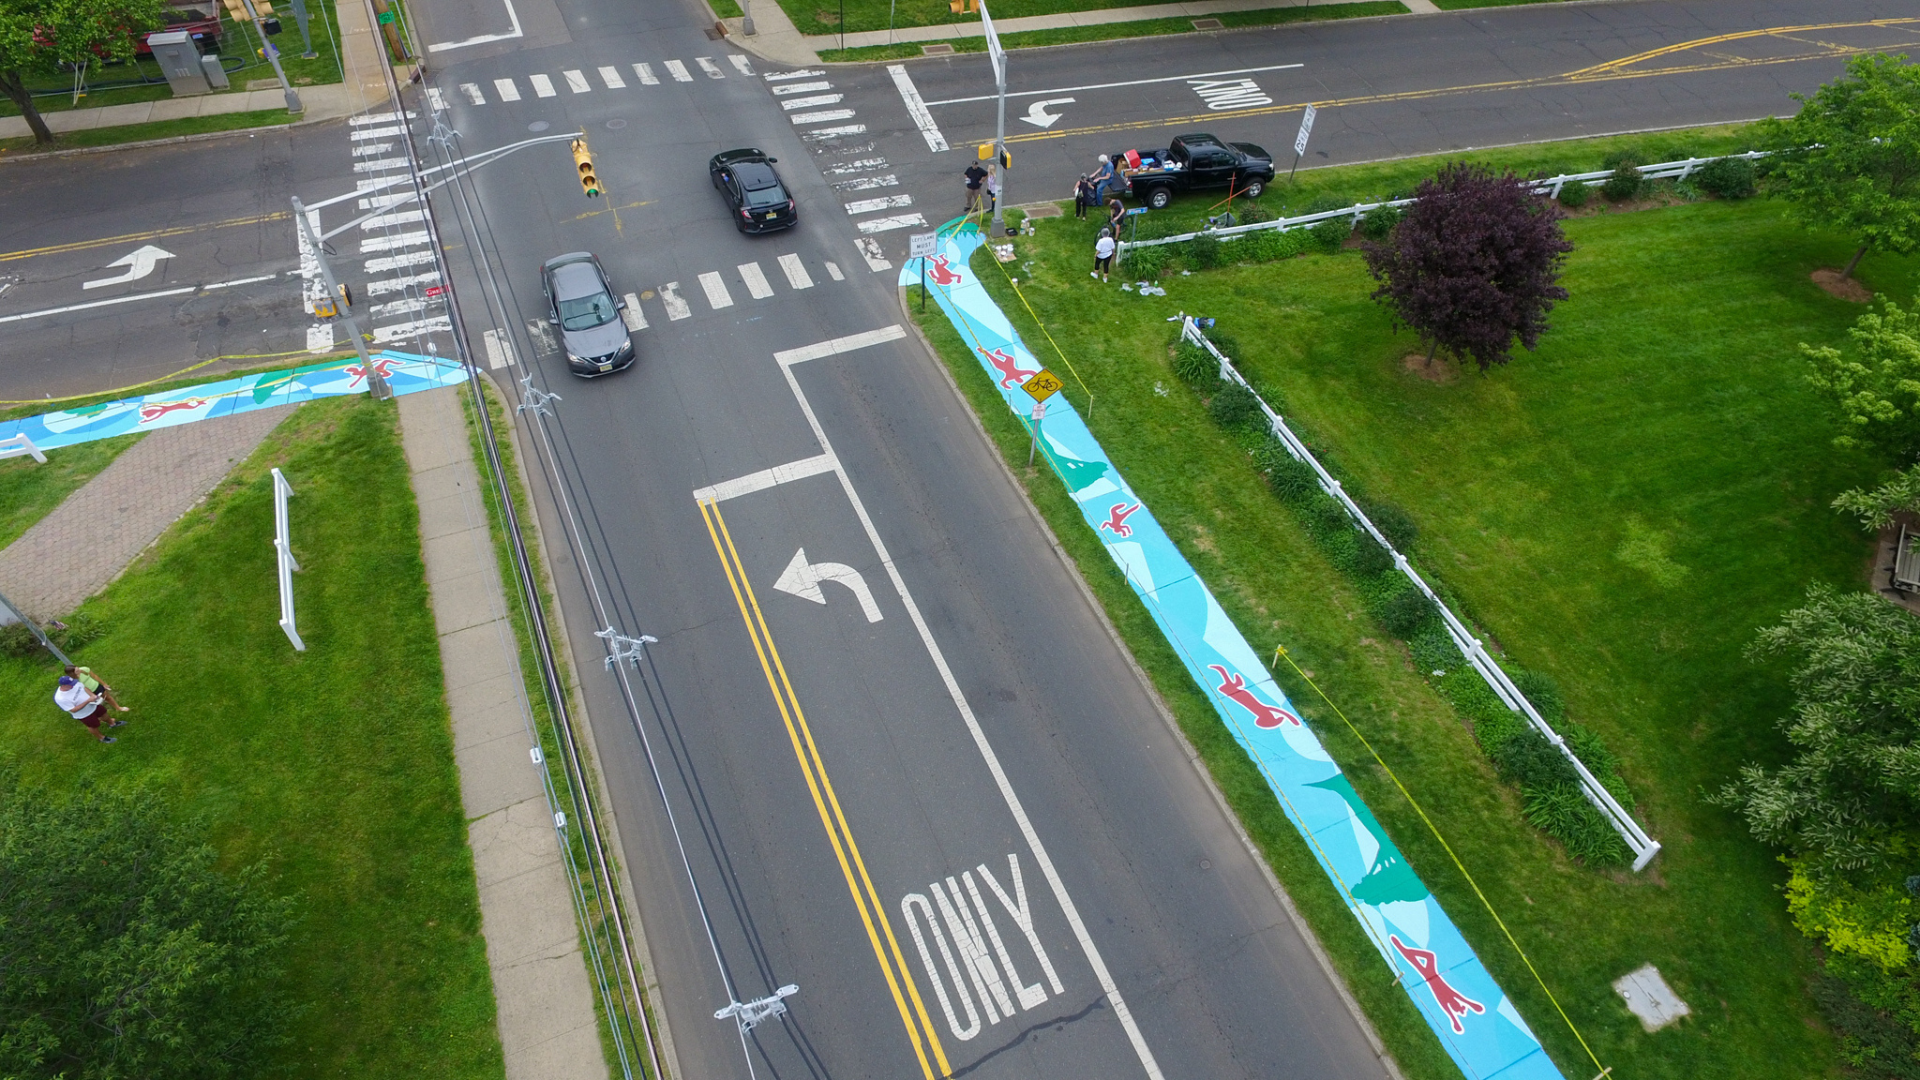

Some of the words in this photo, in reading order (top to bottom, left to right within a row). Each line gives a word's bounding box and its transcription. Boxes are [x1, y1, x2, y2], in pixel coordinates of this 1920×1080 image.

[1187, 78, 1273, 110] ONLY
[1296, 140, 1304, 152] 25
[901, 853, 1065, 1041] ONLY
